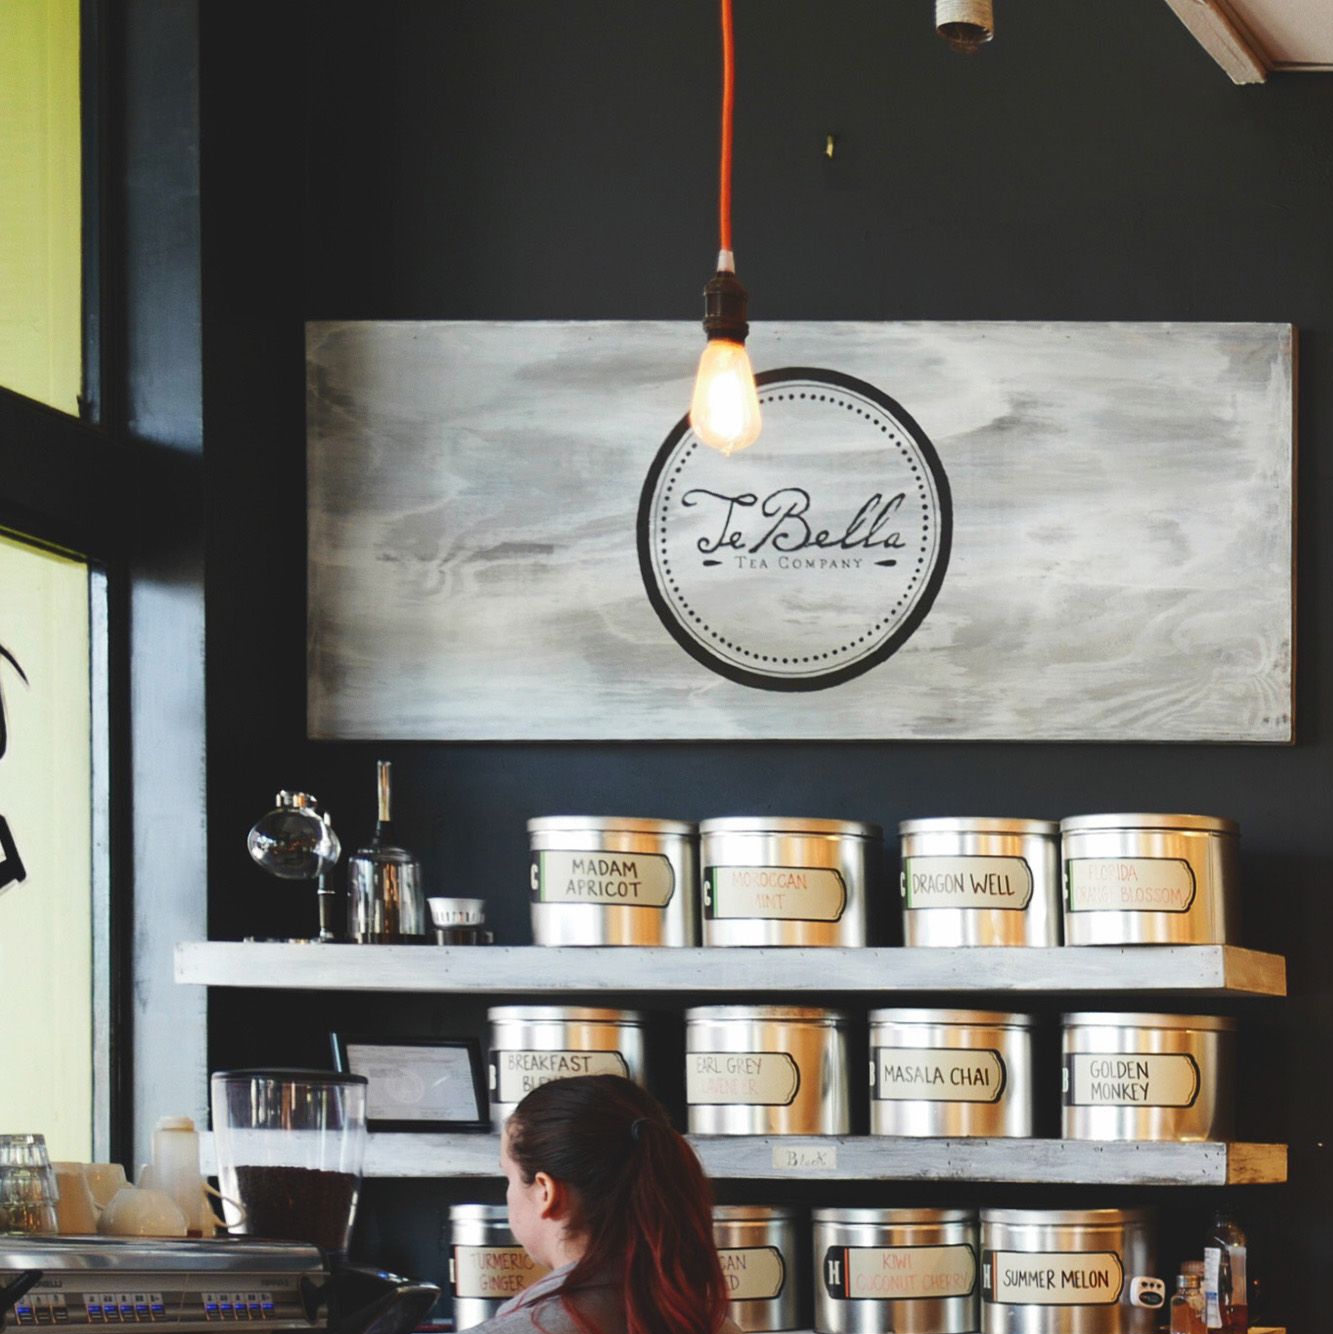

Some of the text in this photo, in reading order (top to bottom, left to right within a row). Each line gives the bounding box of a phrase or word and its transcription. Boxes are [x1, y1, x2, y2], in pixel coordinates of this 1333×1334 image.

[572, 859, 638, 879] MADAM
[566, 879, 641, 898] APRICOT
[912, 872, 1015, 896] DRAGON WELL
[507, 1054, 591, 1072] BREAKFAST
[696, 1056, 762, 1075] EARL GREY
[1091, 1060, 1149, 1080] GOLDEN
[884, 1065, 990, 1087] MASALA CHAI
[1091, 1082, 1150, 1101] MONKEY
[882, 1253, 912, 1270] KIWI
[480, 1274, 524, 1291] GINGER
[1003, 1269, 1109, 1289] SUMMER MELON
